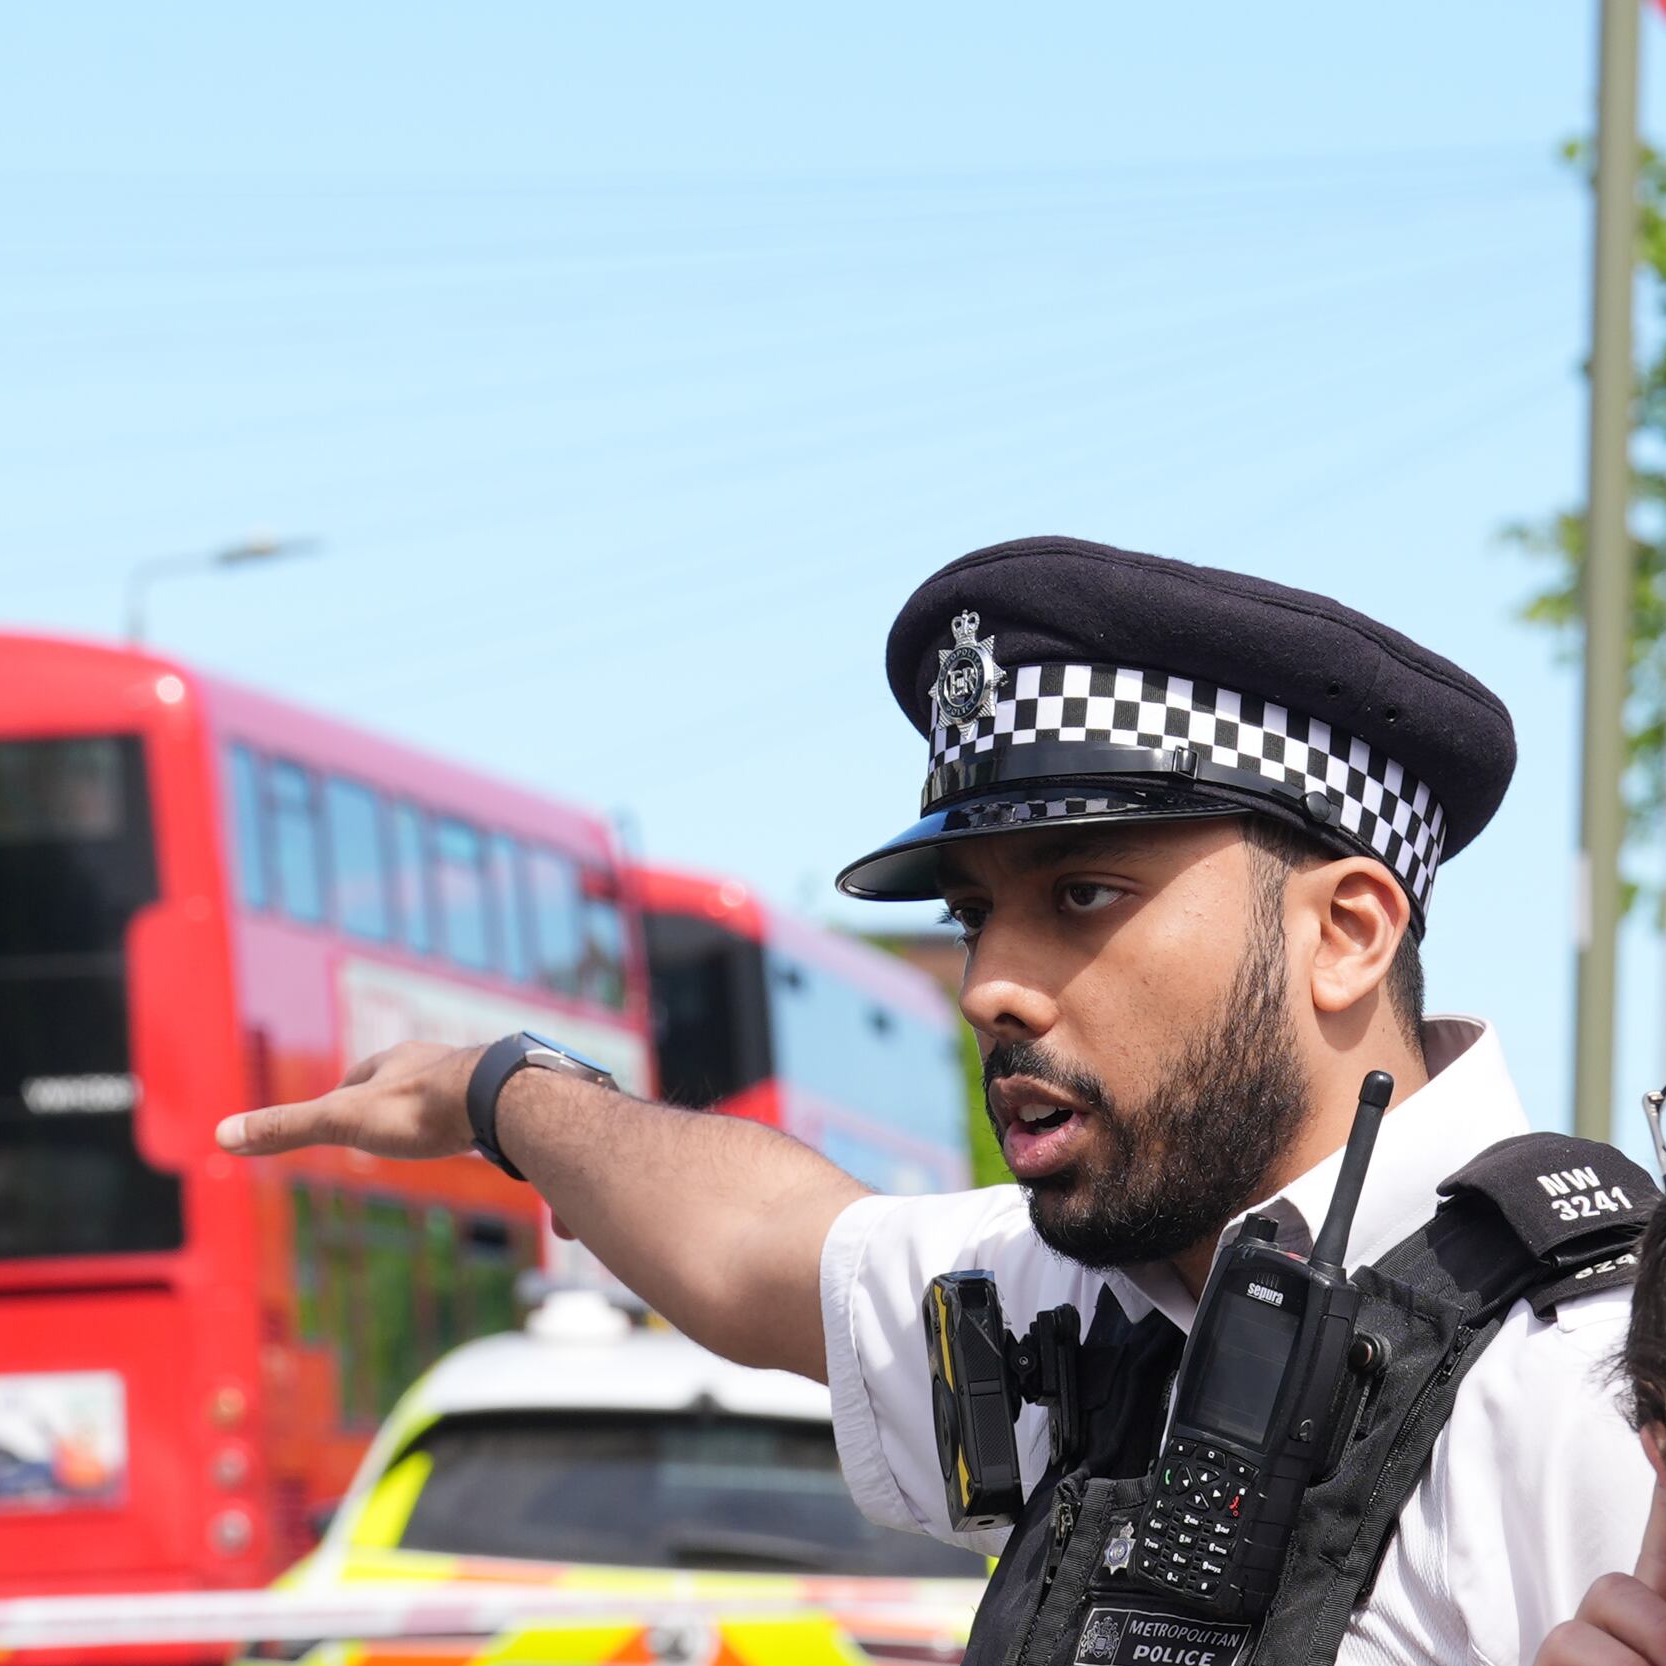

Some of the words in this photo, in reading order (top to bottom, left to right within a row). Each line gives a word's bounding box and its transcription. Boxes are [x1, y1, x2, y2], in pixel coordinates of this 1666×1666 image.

[1537, 1166, 1601, 1197] NW
[1551, 1187, 1633, 1221] 3241
[1247, 1282, 1284, 1305] sepura
[1128, 1618, 1240, 1649] METROPOLITAN
